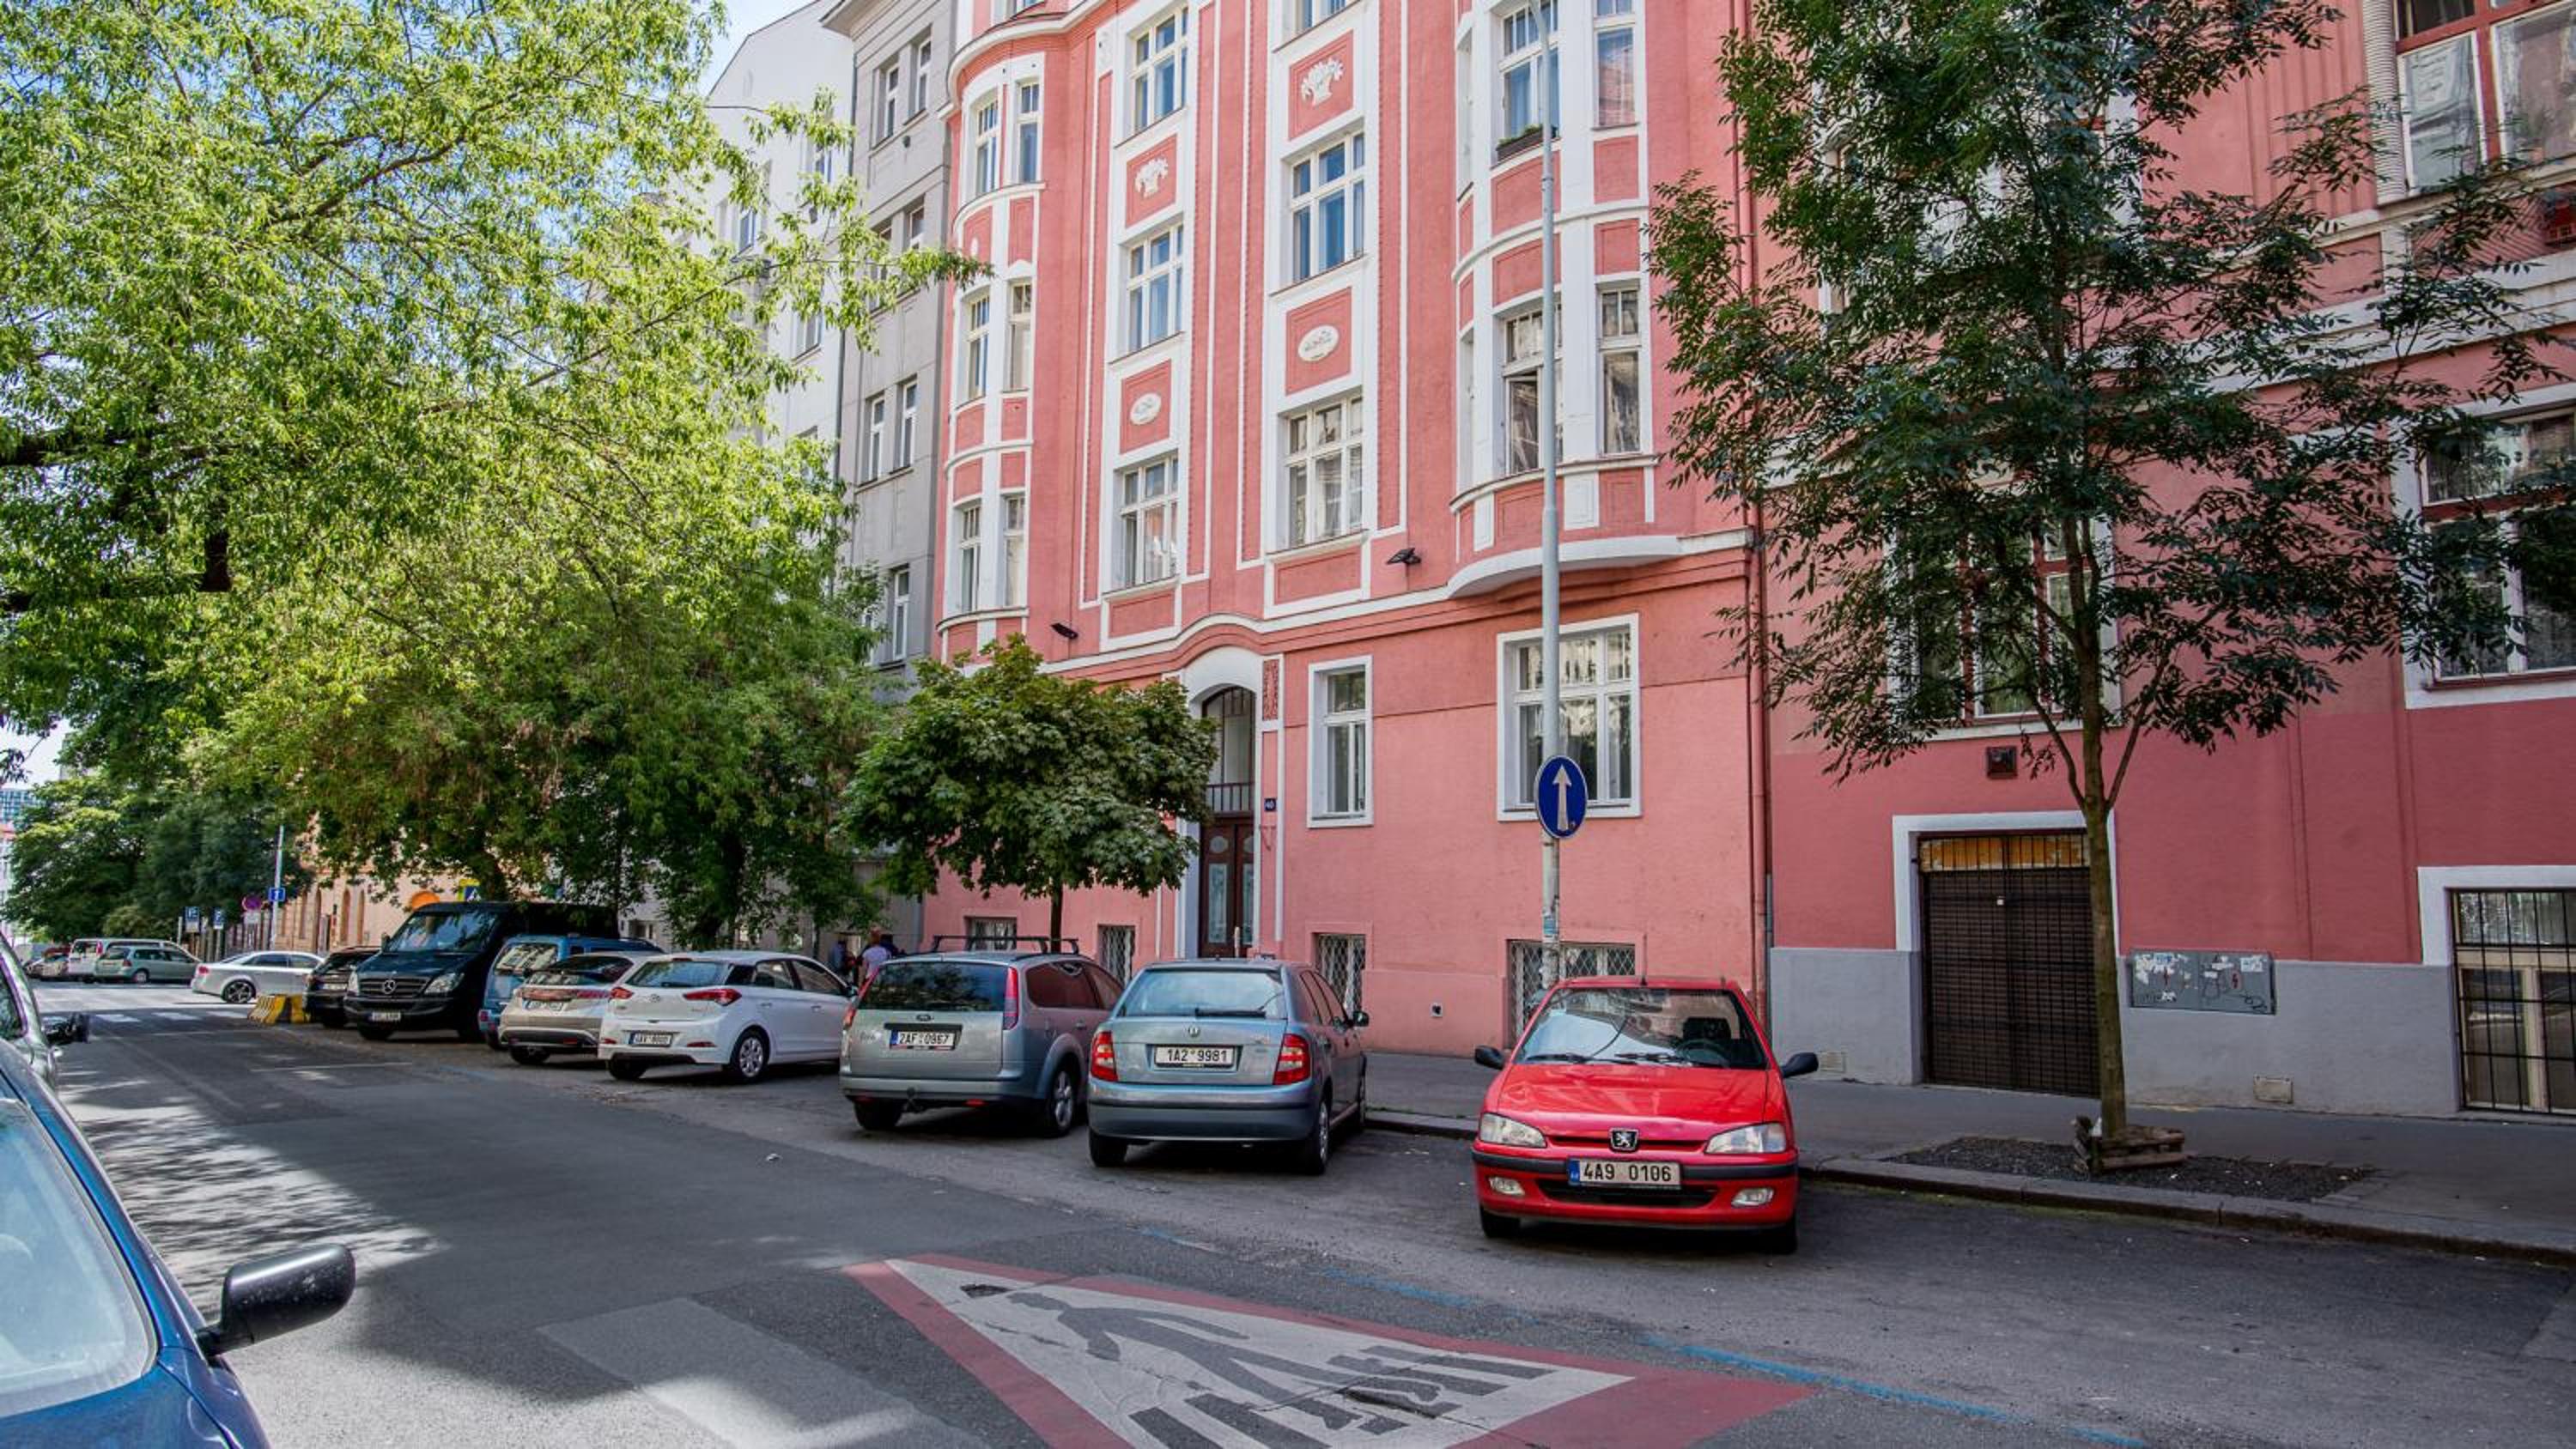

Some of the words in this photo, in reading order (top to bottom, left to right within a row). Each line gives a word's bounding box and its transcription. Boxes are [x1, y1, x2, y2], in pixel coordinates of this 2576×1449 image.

[900, 1033, 918, 1044] 2AF
[1168, 1049, 1188, 1062] 1A2
[1197, 1049, 1227, 1062] 9981
[1583, 1163, 1615, 1180] 4A9
[1629, 1165, 1672, 1182] 0106
